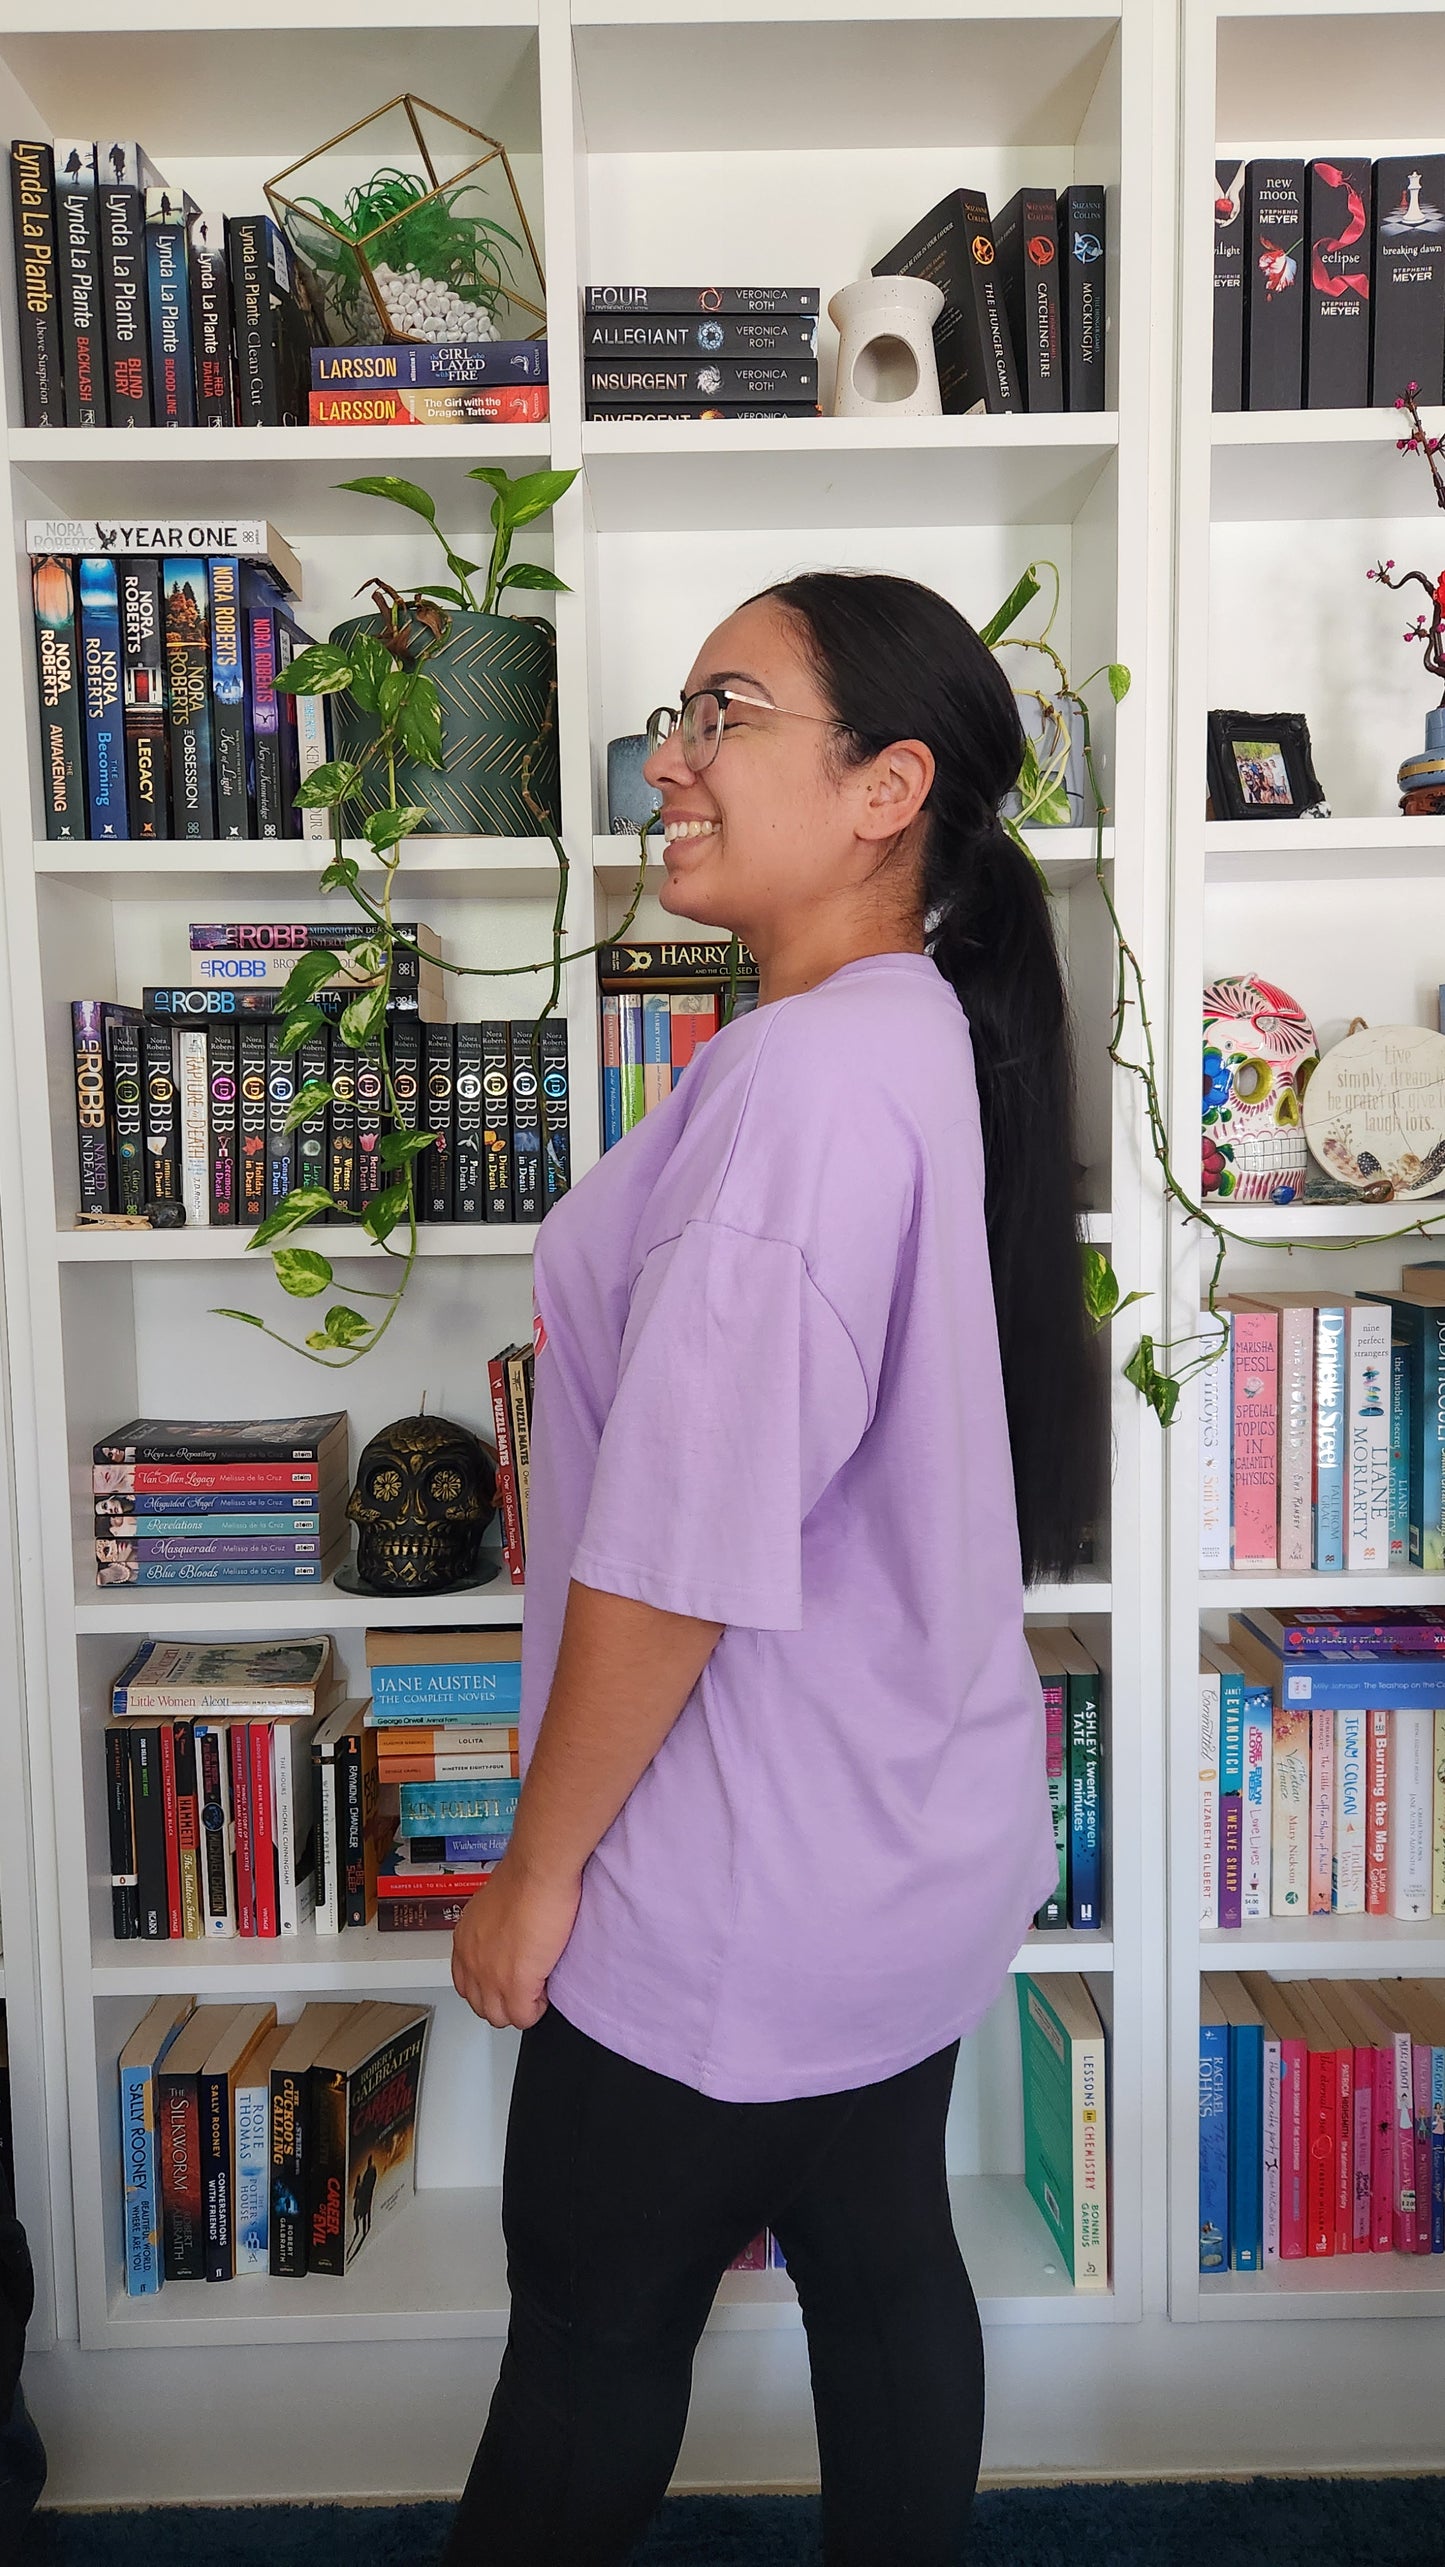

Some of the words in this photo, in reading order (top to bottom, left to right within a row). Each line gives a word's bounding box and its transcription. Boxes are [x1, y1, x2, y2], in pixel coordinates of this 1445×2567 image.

[13, 143, 48, 205] Lynda
[1266, 179, 1292, 189] new
[1259, 189, 1299, 202] moon
[23, 211, 49, 237] La
[1259, 215, 1298, 224] MEYER
[239, 225, 257, 263] Lynda
[1383, 245, 1418, 260] breaking
[1420, 244, 1442, 254] dawn
[244, 266, 258, 280] La
[1322, 253, 1360, 271] eclipse
[24, 243, 53, 313] Plante
[245, 284, 259, 326] Plante
[591, 287, 648, 305] FOUR
[736, 289, 788, 299] VERONICA
[749, 301, 775, 310] ROTH
[984, 283, 996, 306] THE
[1037, 283, 1049, 348] CATCHING
[1082, 283, 1093, 364] MOCKINGJAY
[1321, 307, 1359, 316] MEYER
[35, 317, 47, 352] Above
[591, 329, 689, 345] ALLEGIANT
[987, 309, 1004, 354] HUNGER
[247, 331, 261, 374] Clean
[533, 348, 542, 377] Quercus
[1040, 352, 1050, 378] FIRE
[37, 353, 49, 404] Suspicion
[76, 336, 92, 401] BACKLASH
[114, 361, 129, 396] FURY
[128, 358, 143, 399] BLIND
[164, 358, 176, 391] BLOOD
[319, 357, 397, 380] LARSSON
[591, 373, 688, 390] INSURGENT
[996, 359, 1011, 399] GAMES
[166, 394, 177, 415] LINE
[250, 378, 263, 406] Cut
[424, 399, 442, 408] The
[444, 398, 463, 407] Girl
[464, 398, 483, 407] with
[485, 397, 502, 406] the
[319, 400, 396, 421] LARSSON
[427, 408, 464, 418] Dragon
[466, 407, 498, 416] Tattoo
[34, 535, 96, 550] ROBERTS
[45, 522, 84, 537] NORA
[120, 528, 182, 547] YEAR
[187, 527, 238, 547] ONE
[124, 576, 141, 654] ROBERTS
[139, 590, 153, 639] NORA
[49, 724, 67, 812] AWAKENING
[95, 732, 113, 806] Becoming
[138, 738, 153, 803] LEGACY
[183, 735, 199, 809] OBSESSION
[239, 925, 308, 949] ROBB
[211, 959, 267, 978] ROBB
[660, 945, 730, 966] HARRY
[171, 990, 236, 1014] ROBB
[1385, 1045, 1411, 1065] Live
[1365, 1111, 1401, 1132] laugh
[1405, 1112, 1435, 1131] lots.
[82, 1135, 93, 1150] IN
[82, 1152, 96, 1195] DEATH
[94, 1143, 107, 1190] NAKED
[215, 1161, 224, 1169] in
[360, 1155, 368, 1165] in
[368, 1155, 379, 1191] Betrayal
[459, 1154, 468, 1164] in
[469, 1160, 478, 1187] Purity
[215, 1172, 224, 1197] Death
[223, 1158, 234, 1200] Ceremony
[360, 1167, 368, 1192] Death
[459, 1167, 468, 1192] Death
[1357, 1336, 1385, 1346] perfect
[1363, 1323, 1381, 1333] nine
[1235, 1341, 1275, 1353] MARISHA
[1317, 1314, 1344, 1408] Danielle
[1353, 1350, 1389, 1360] strangers
[1236, 1356, 1276, 1373] PESSL
[493, 1397, 507, 1435] PUZZLE
[1236, 1403, 1275, 1418] SPECIAL
[1235, 1420, 1276, 1437] TOPICS
[1317, 1411, 1343, 1469] Steel
[496, 1437, 509, 1467] MATES
[1246, 1439, 1263, 1454] IN
[1235, 1455, 1275, 1470] CALAMITY
[1235, 1471, 1276, 1486] PHYSICS
[1352, 1427, 1369, 1541] MORIARTY
[1371, 1446, 1388, 1520] LIANE
[147, 1519, 203, 1531] Revelations
[151, 1540, 218, 1559] Masquerade
[147, 1564, 178, 1578] Blue
[179, 1564, 218, 1578] Bloods
[377, 1677, 423, 1693] JANE
[427, 1675, 497, 1691] AUSTEN
[379, 1695, 399, 1705] THE
[403, 1693, 453, 1704] COMPLETE
[457, 1692, 496, 1702] NOVELS
[130, 1695, 154, 1707] Little
[157, 1695, 196, 1707] Women
[200, 1695, 230, 1707] Alcott
[1073, 1711, 1085, 1746] TATE
[1084, 1700, 1097, 1756] ASHLEY
[1200, 1689, 1219, 1762] Committed
[1225, 1699, 1240, 1775] EVANOVICH
[1344, 1717, 1359, 1758] JENNY
[469, 1763, 504, 1771] EIGHTY-FOUR
[1085, 1760, 1099, 1801] twenty
[1372, 1738, 1387, 1797] Burning
[349, 1765, 357, 1803] RAYMOND
[1343, 1763, 1359, 1816] COLGAN
[1073, 1777, 1084, 1832] minutes
[1375, 1800, 1387, 1827] the
[179, 1799, 193, 1847] HAMMETT
[349, 1808, 358, 1848] CHANDLER
[1086, 1810, 1096, 1848] seven
[1203, 1791, 1212, 1849] ELIZABETH
[1225, 1808, 1237, 1851] TWELVE
[452, 1840, 488, 1851] Wuthering
[1372, 1830, 1387, 1863] Map
[183, 1854, 193, 1870] The
[1203, 1853, 1212, 1899] GILBERT
[1226, 1857, 1237, 1893] SHARP
[184, 1871, 194, 1904] Maltese
[185, 1905, 195, 1933] Falcon
[169, 2088, 184, 2097] THE
[1083, 2055, 1094, 2107] LESSONS
[1199, 2057, 1213, 2118] JOHNS
[1213, 2057, 1224, 2115] RACHAEL
[129, 2083, 145, 2121] SALLY
[283, 2079, 294, 2155] CUCKOO'S
[240, 2094, 252, 2159] THOMAS
[252, 2104, 264, 2149] ROSIE
[273, 2095, 283, 2165] CALLING
[131, 2128, 148, 2190] ROONEY
[170, 2099, 189, 2190] SILKWORM
[1084, 2126, 1095, 2190] CHEMISTRY
[209, 2179, 217, 2202] WITH
[132, 2205, 140, 2232] WHERE
[141, 2200, 151, 2241] BEAUTIFUL
[209, 2204, 217, 2241] FRIENDS
[217, 2172, 227, 2246] CONVERSATIONS
[1081, 2202, 1090, 2248] GARMUS
[1090, 2204, 1099, 2246] BONNIE
[132, 2235, 140, 2252] ARE
[142, 2242, 152, 2273] WORLD,
[133, 2252, 141, 2271] YOU
